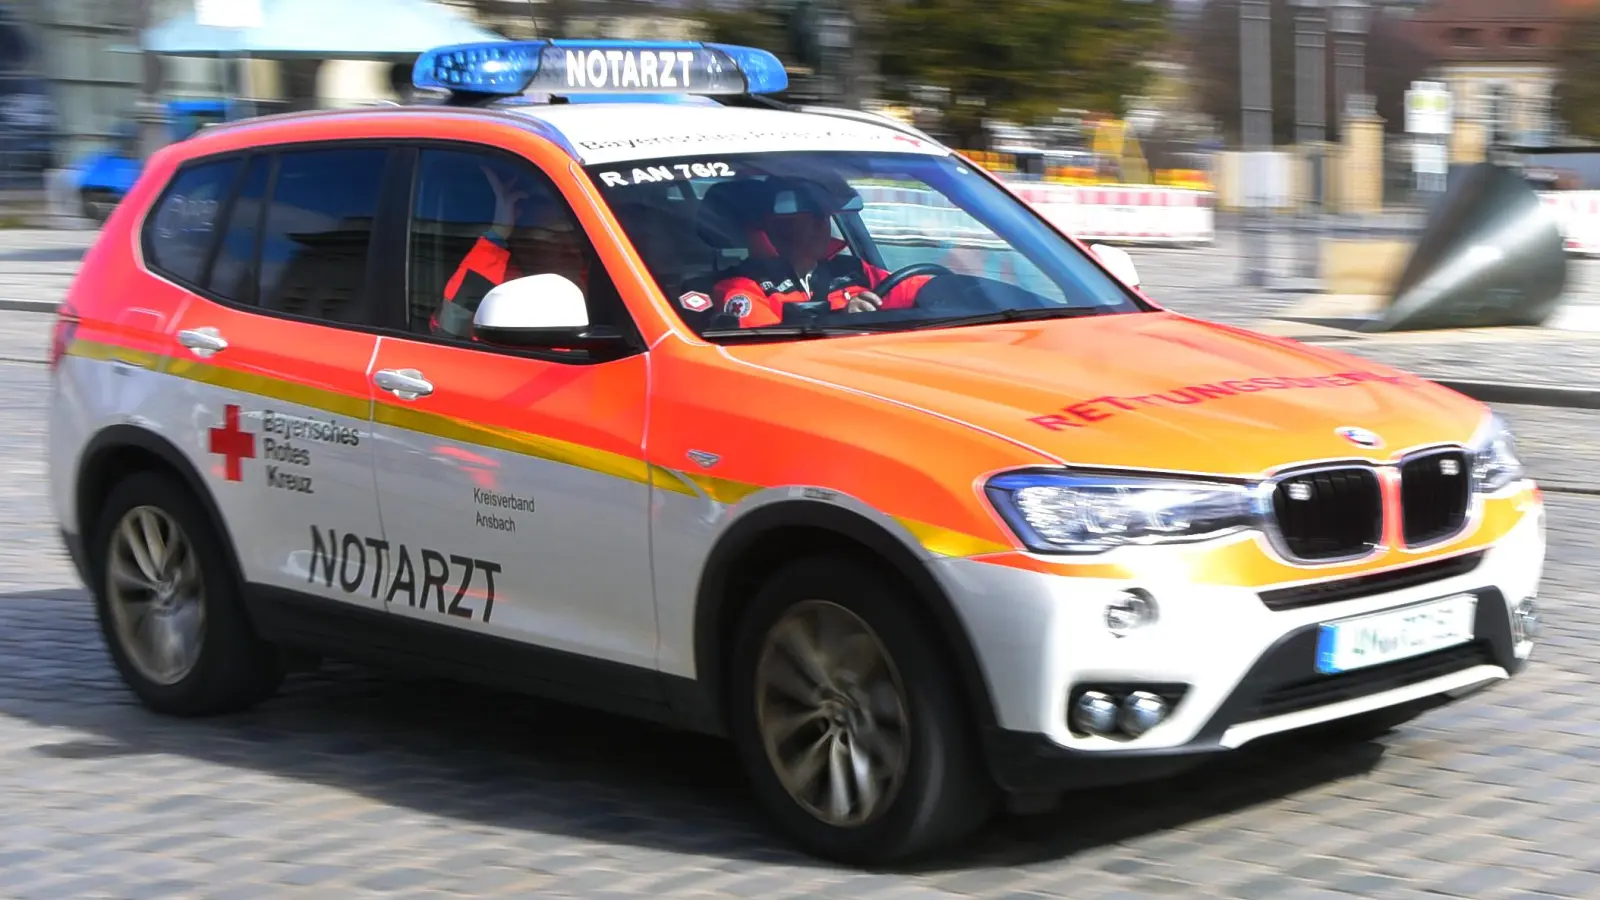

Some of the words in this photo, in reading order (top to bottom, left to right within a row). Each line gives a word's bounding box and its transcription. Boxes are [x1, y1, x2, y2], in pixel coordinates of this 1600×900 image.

[566, 50, 694, 88] NOTARZT
[600, 171, 629, 187] R
[631, 165, 675, 184] AN
[673, 162, 736, 179] 76/2
[263, 409, 360, 446] Bayerisches
[263, 437, 310, 466] Rotes
[266, 465, 314, 494] Kreuz
[473, 487, 535, 513] Kreisverband
[475, 511, 516, 534] Ansbach
[307, 524, 502, 623] NOTARZT
